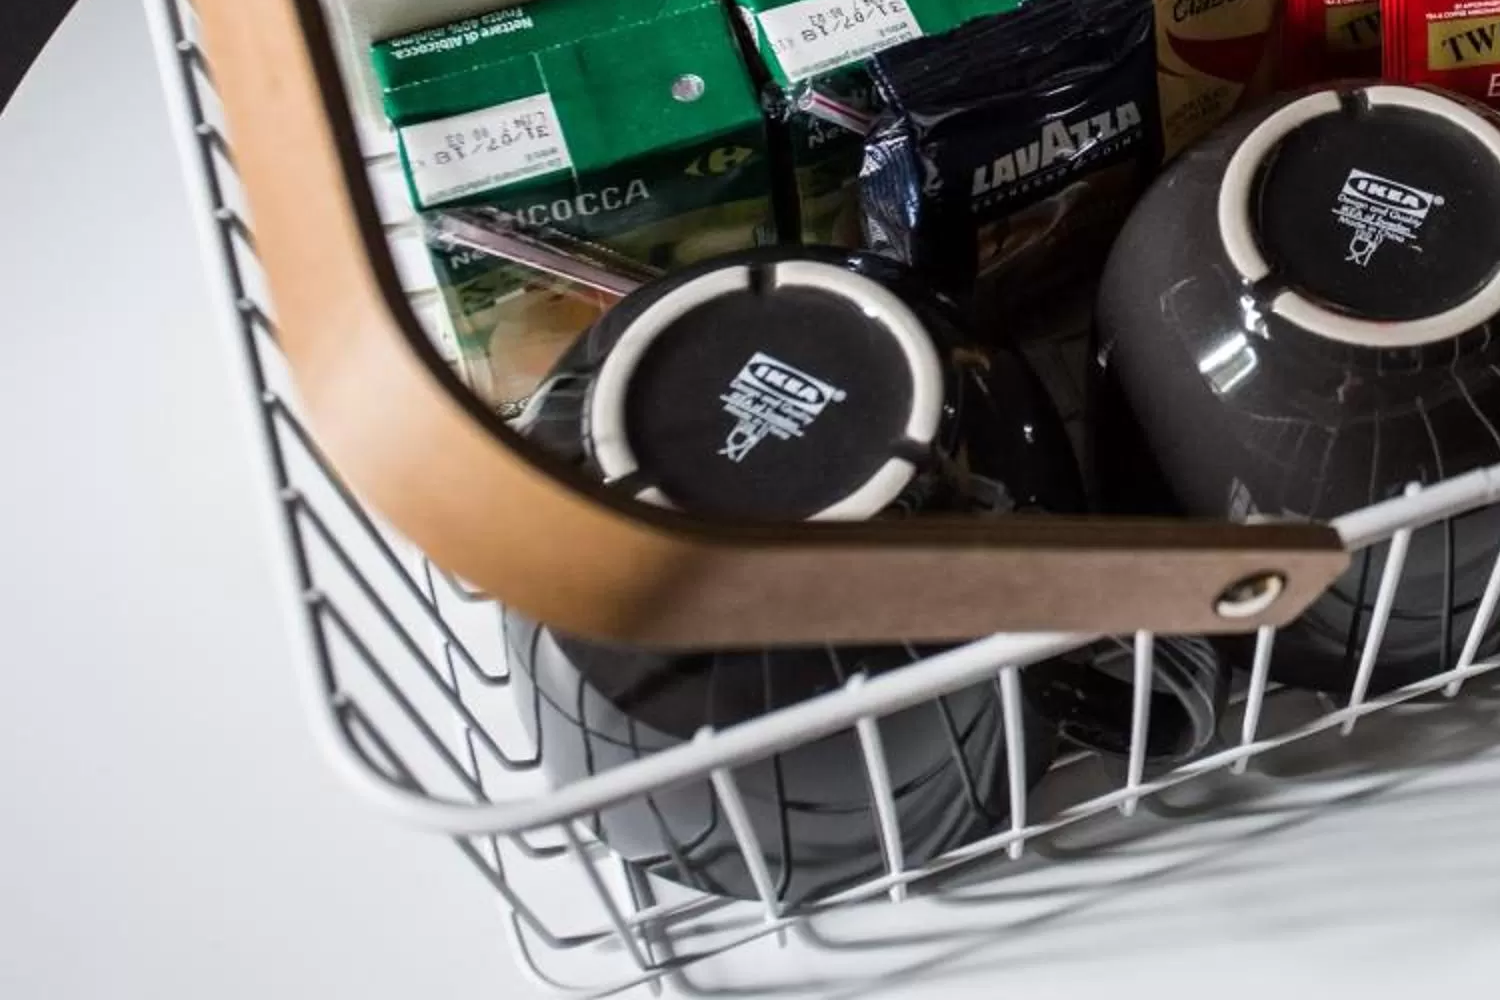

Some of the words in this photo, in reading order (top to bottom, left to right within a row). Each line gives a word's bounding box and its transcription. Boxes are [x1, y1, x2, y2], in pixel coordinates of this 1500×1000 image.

[480, 16, 534, 38] Nettare
[971, 100, 1142, 197] LAVAZZA
[1354, 178, 1423, 210] IKEA
[752, 364, 821, 403] IKEA
